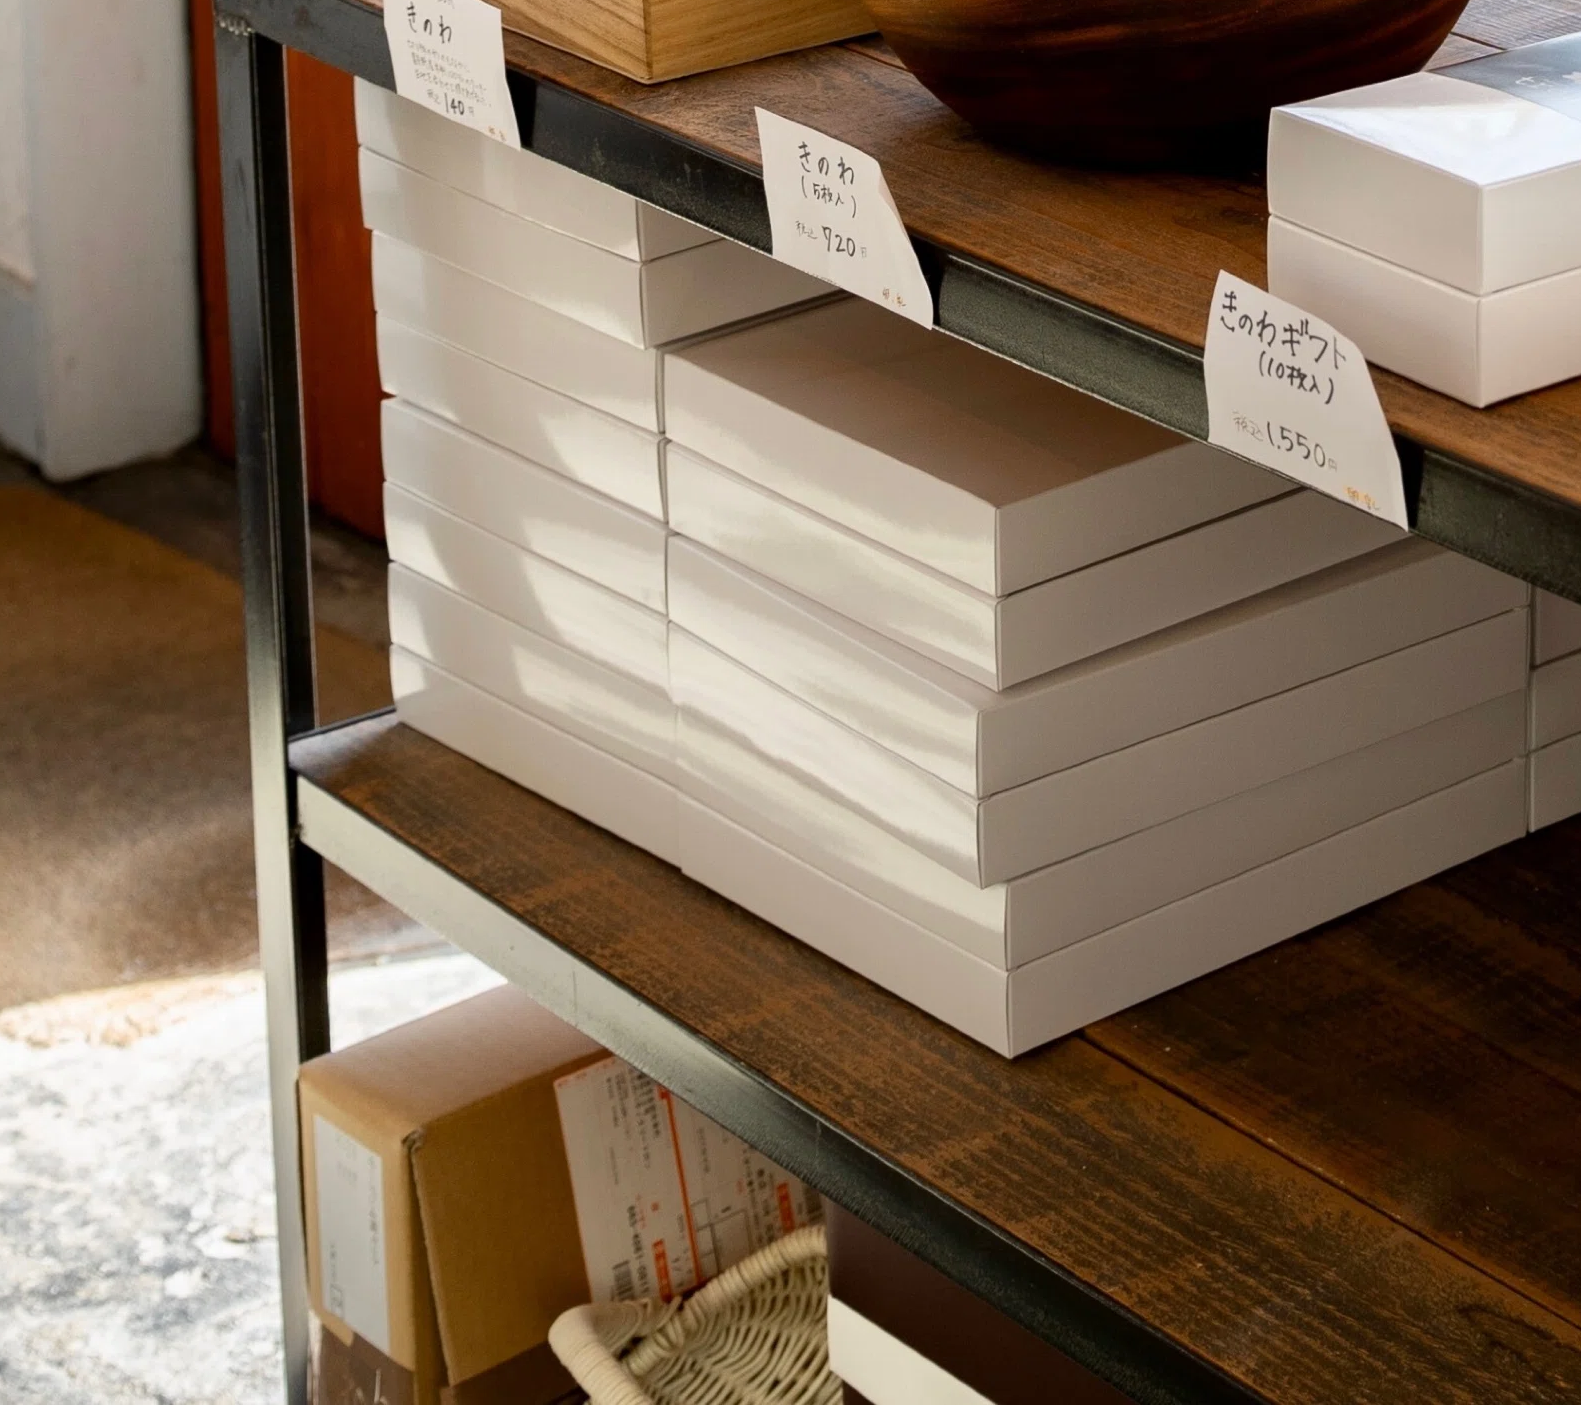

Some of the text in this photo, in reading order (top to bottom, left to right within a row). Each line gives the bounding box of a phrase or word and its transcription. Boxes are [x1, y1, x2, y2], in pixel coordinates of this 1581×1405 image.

[407, 1, 452, 44] きのわ
[798, 141, 854, 185] きのわ
[1219, 290, 1346, 370] きのわギフト
[1258, 350, 1334, 405] (10枚入)
